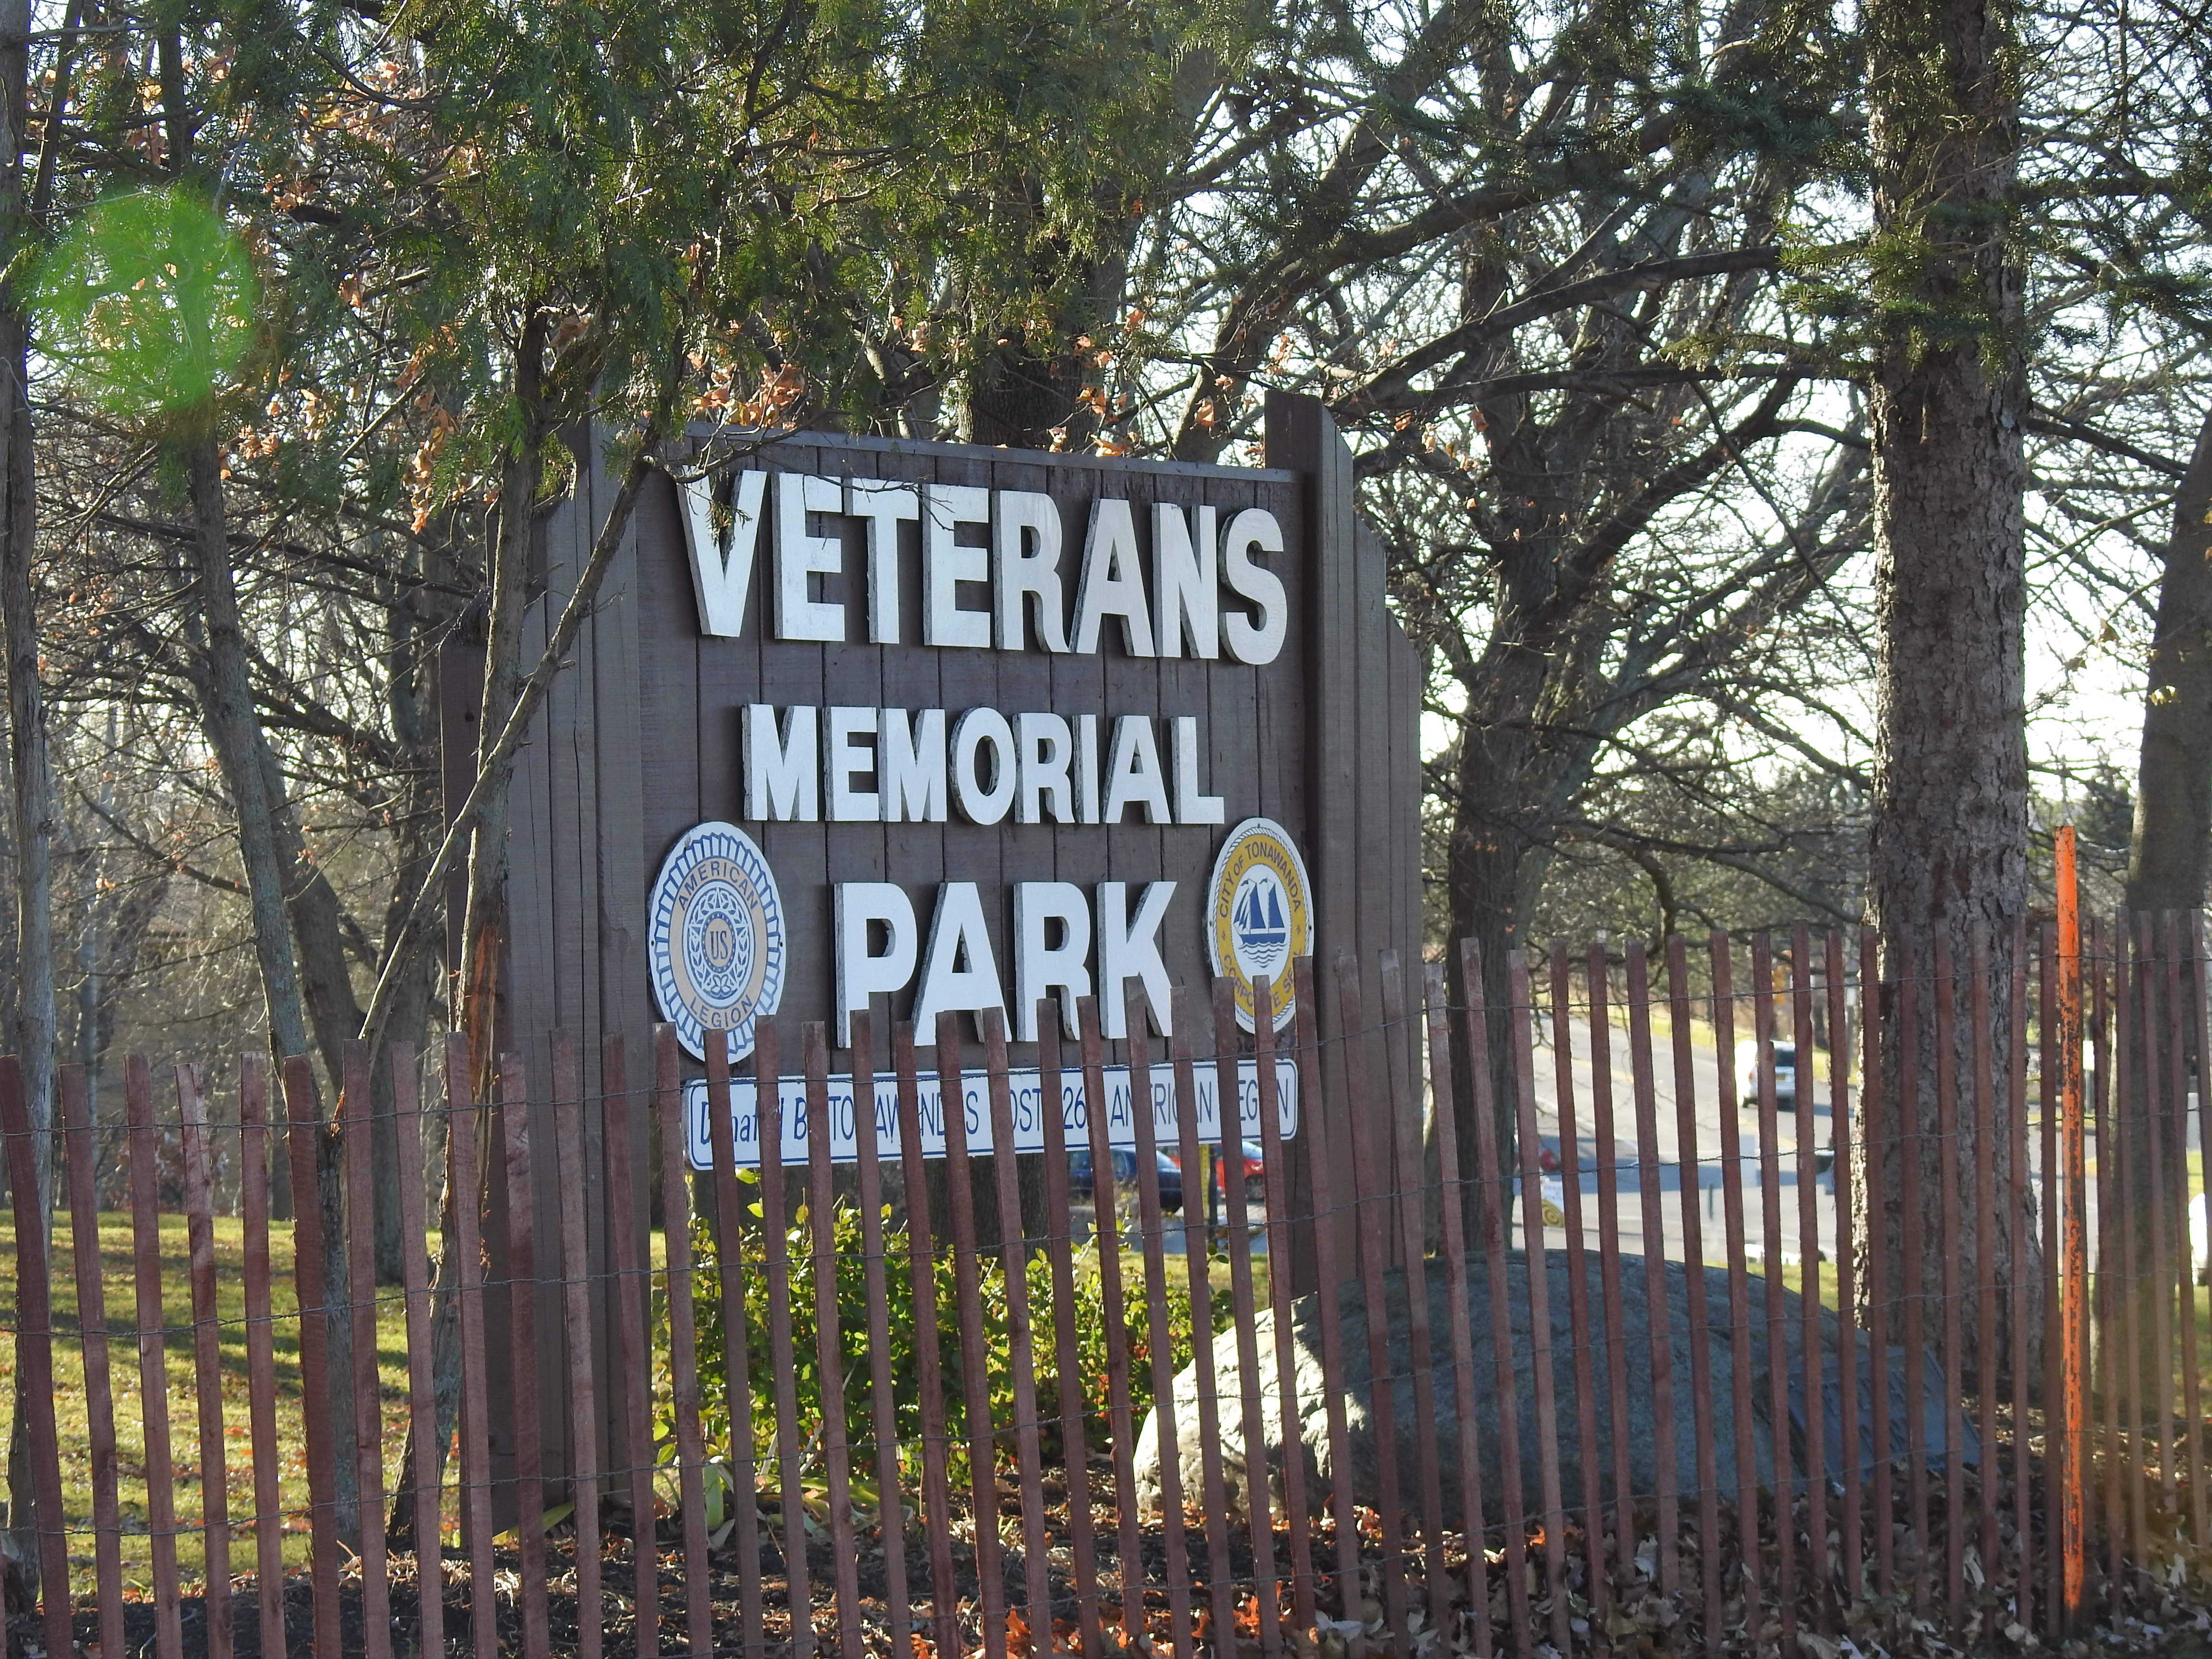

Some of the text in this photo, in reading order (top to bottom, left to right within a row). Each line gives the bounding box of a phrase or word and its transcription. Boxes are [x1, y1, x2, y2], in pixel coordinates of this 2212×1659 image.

[677, 464, 1287, 665] VETERANS
[742, 703, 1225, 826] MEMORIAL
[678, 861, 758, 911] AMERICAN
[1220, 841, 1301, 918] CITY OF TONAWANDA
[710, 930, 729, 960] US
[834, 881, 1177, 1048] PARK
[690, 994, 753, 1028] LEGION
